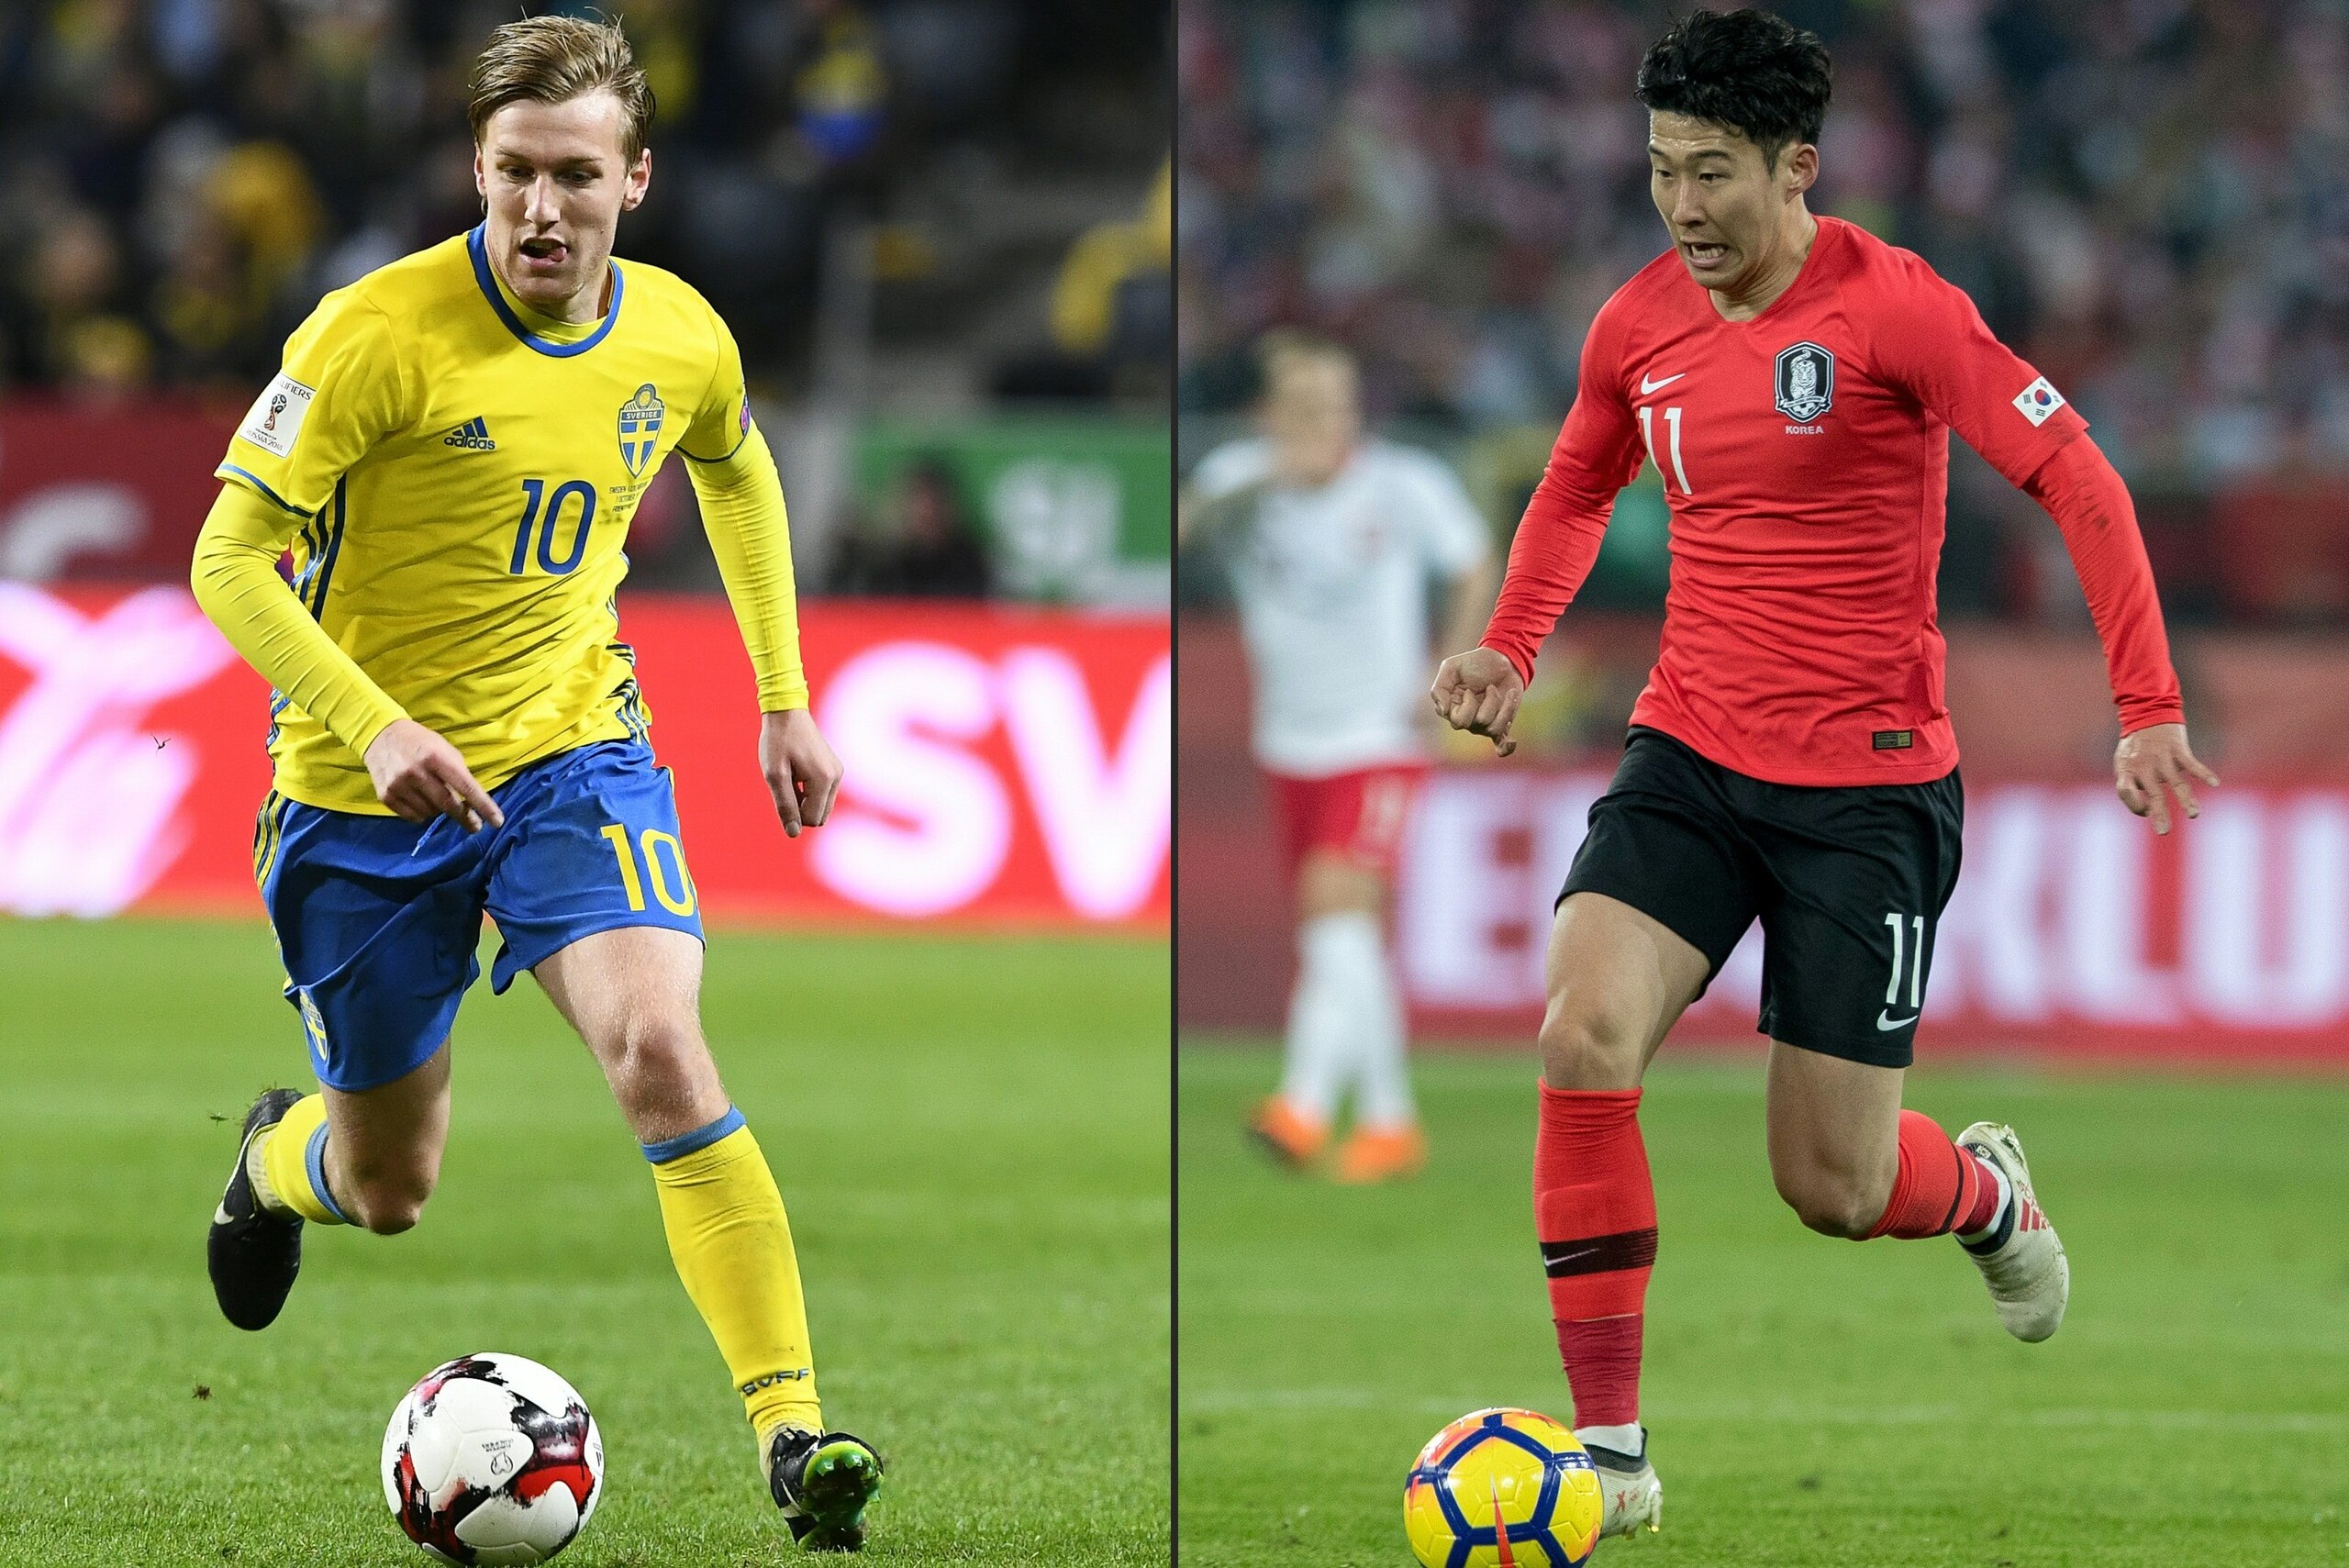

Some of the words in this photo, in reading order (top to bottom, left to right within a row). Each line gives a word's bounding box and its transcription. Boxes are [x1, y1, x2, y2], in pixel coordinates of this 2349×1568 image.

[443, 435, 496, 450] adidas
[626, 410, 659, 420] SVERIGE
[1785, 425, 1825, 435] KOREA
[1639, 406, 1693, 495] 11
[509, 479, 597, 576] 10
[600, 823, 695, 917] 10
[1884, 912, 1924, 1008] 11
[740, 1367, 809, 1396] SVFF
